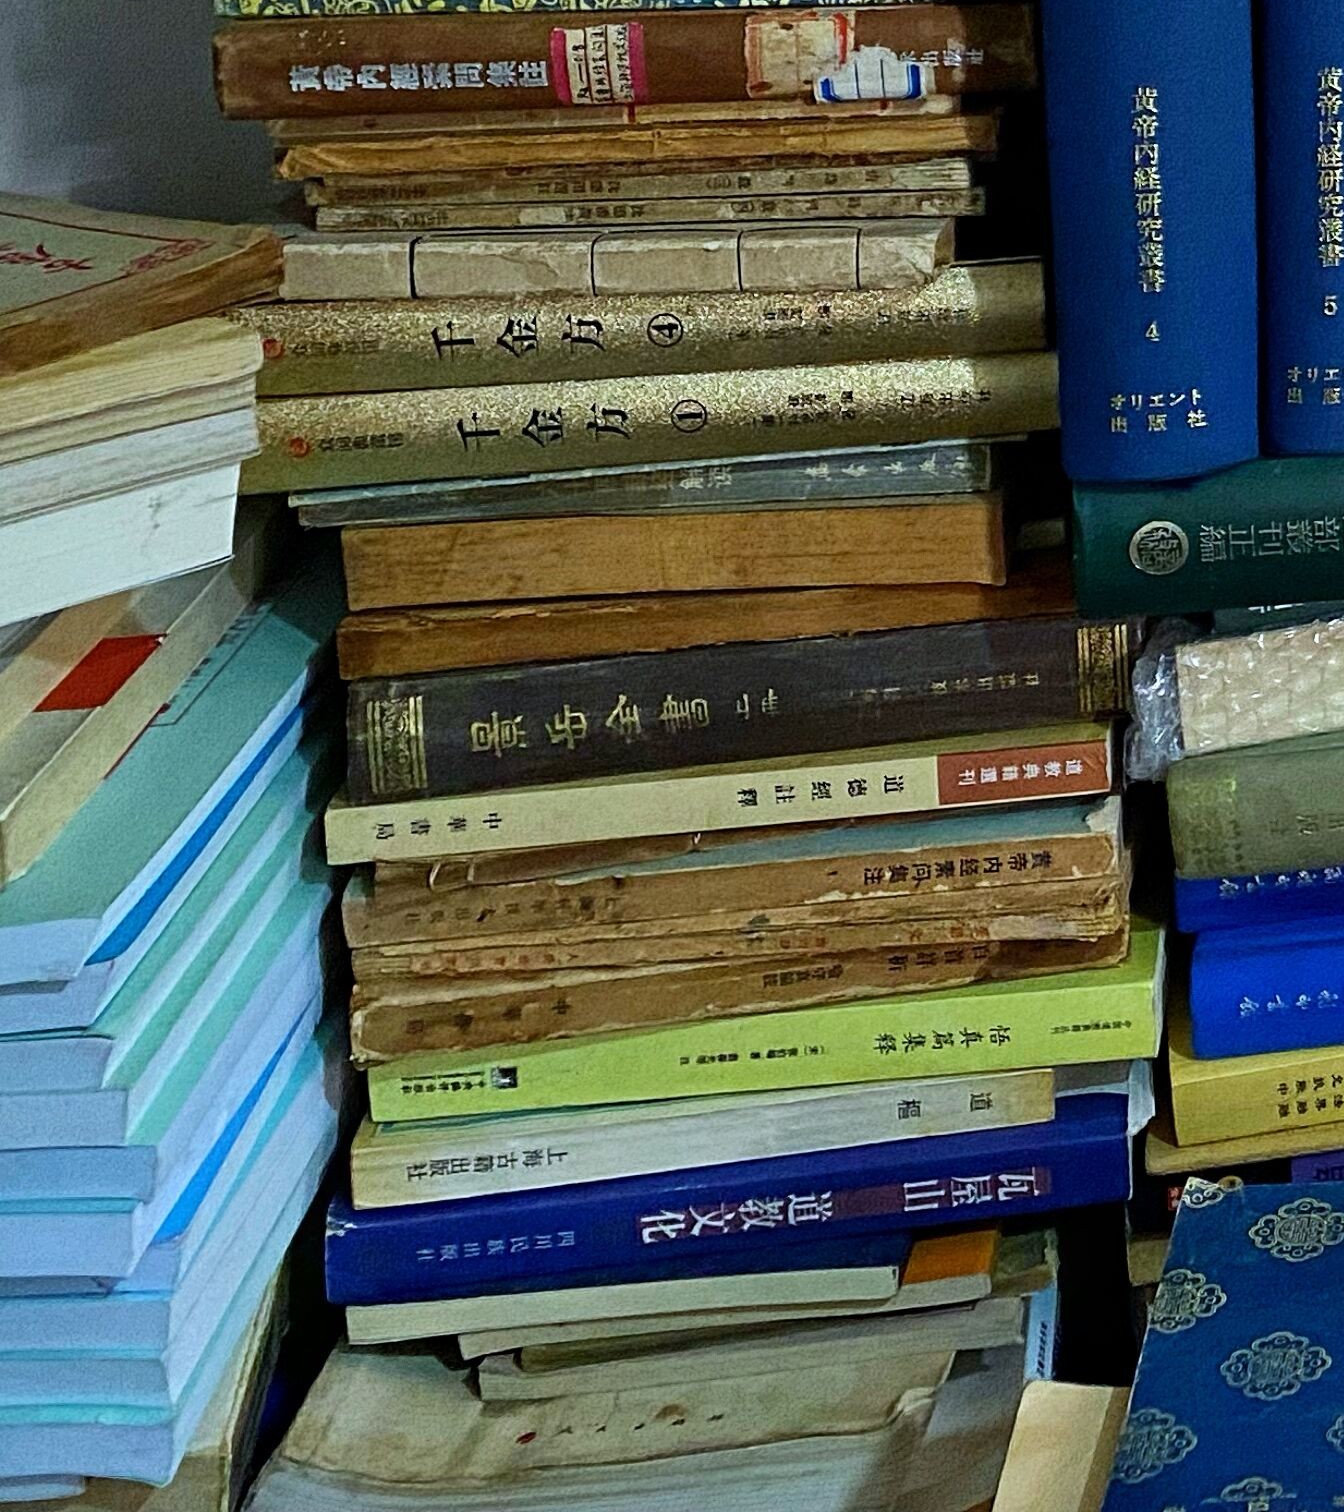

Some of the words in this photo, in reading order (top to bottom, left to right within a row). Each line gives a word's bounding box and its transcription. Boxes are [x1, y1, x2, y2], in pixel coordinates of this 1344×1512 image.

[1324, 296, 1337, 316] 5
[431, 313, 605, 360] 千金方
[1145, 322, 1161, 342] 4
[1109, 388, 1203, 410] オリエント
[458, 404, 633, 448] 千金方
[1109, 410, 1207, 433] 出版社
[901, 1168, 1040, 1211] 瓦屋山
[639, 1193, 834, 1244] 道教文化
